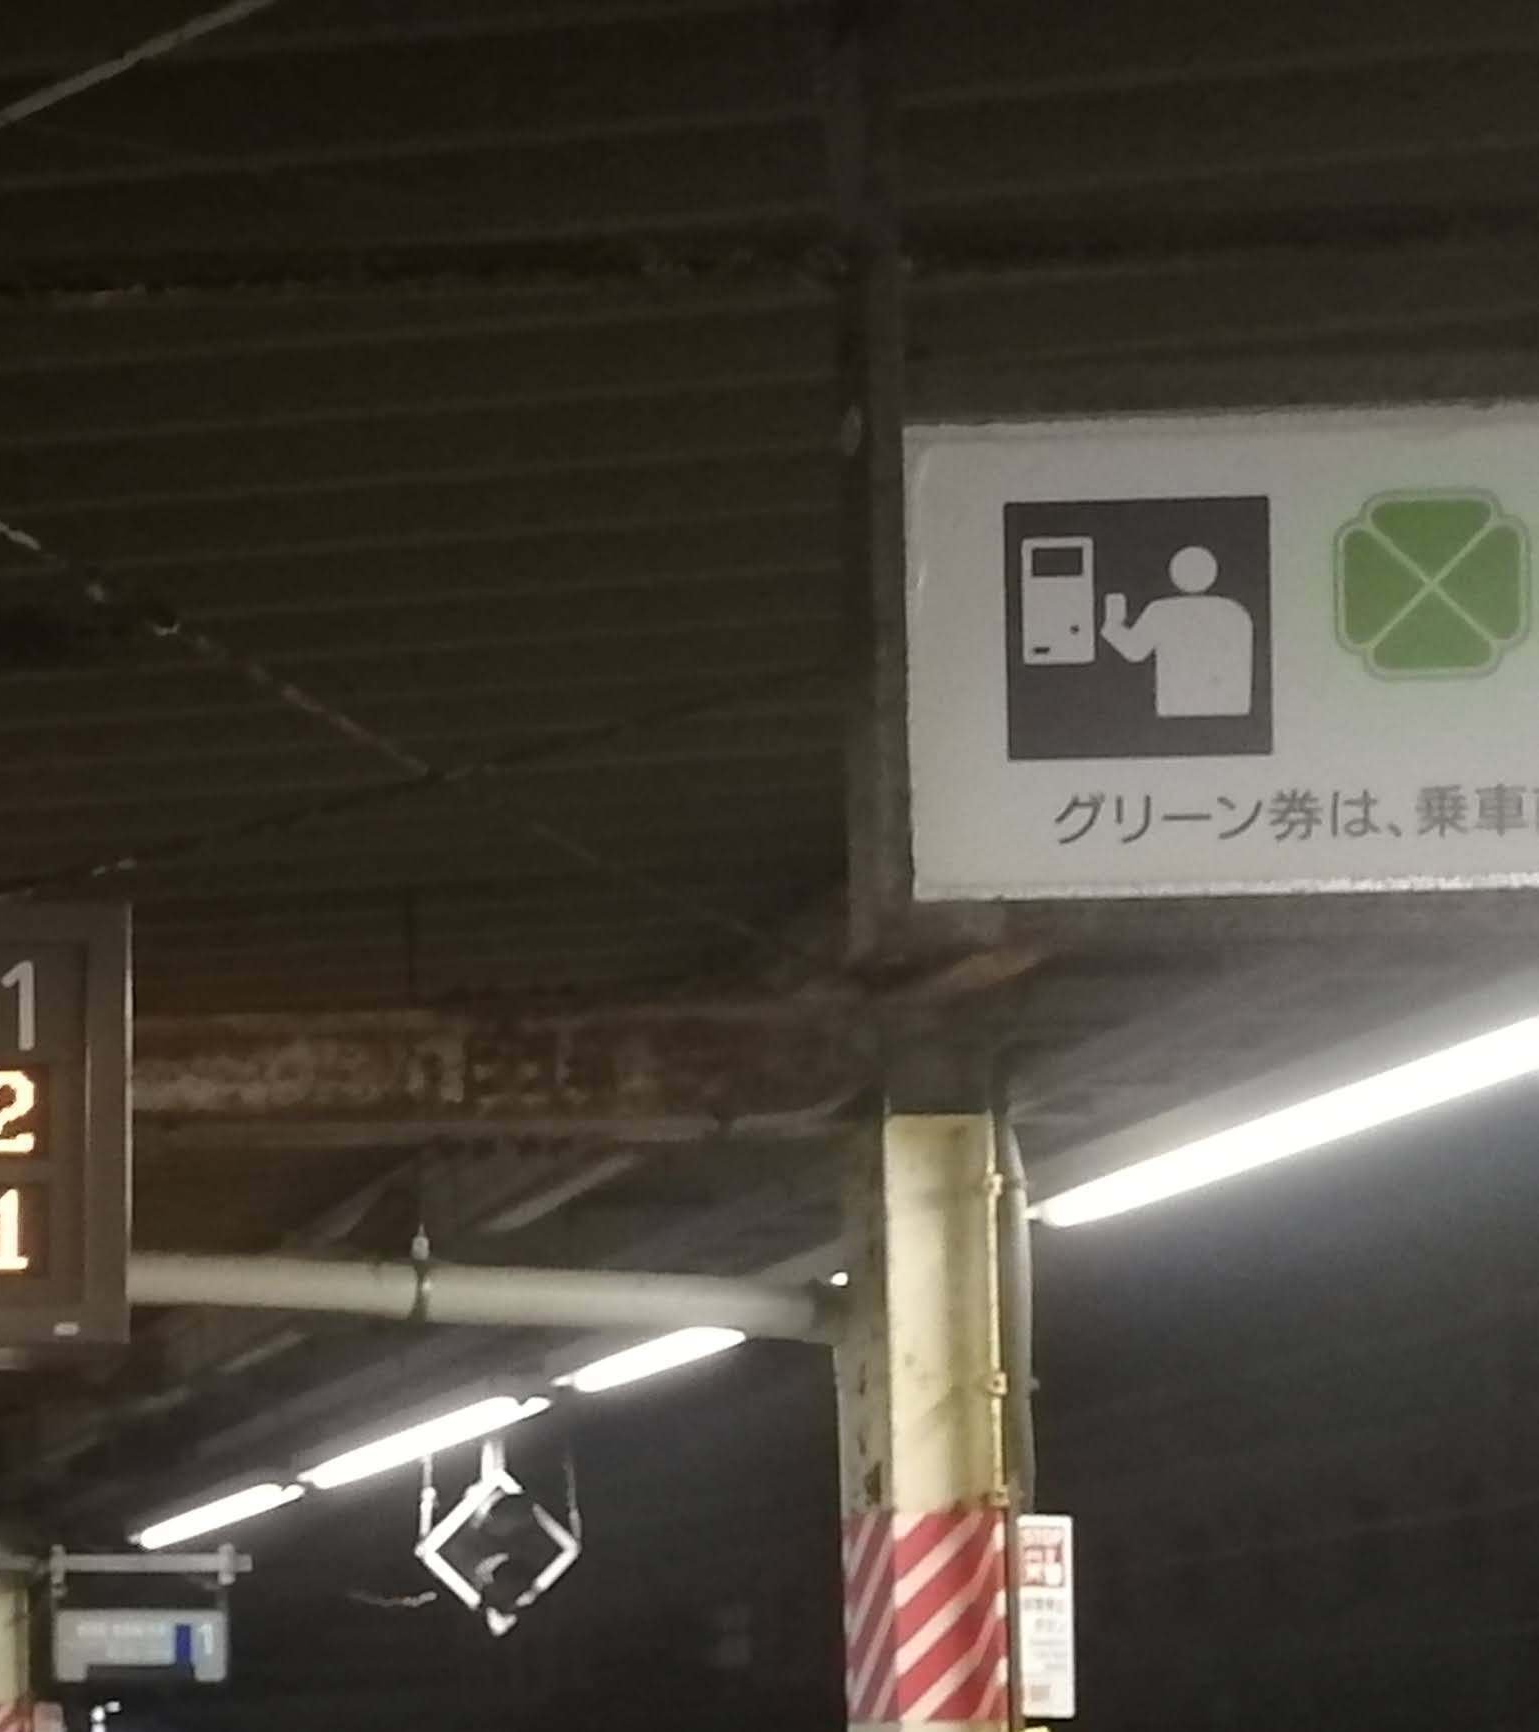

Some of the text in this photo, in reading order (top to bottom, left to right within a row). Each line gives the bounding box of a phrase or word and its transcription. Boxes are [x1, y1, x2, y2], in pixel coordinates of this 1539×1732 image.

[1055, 784, 1539, 844] グリーン券は、乗車
[1, 959, 35, 1051] 1
[199, 1623, 214, 1655] 1
